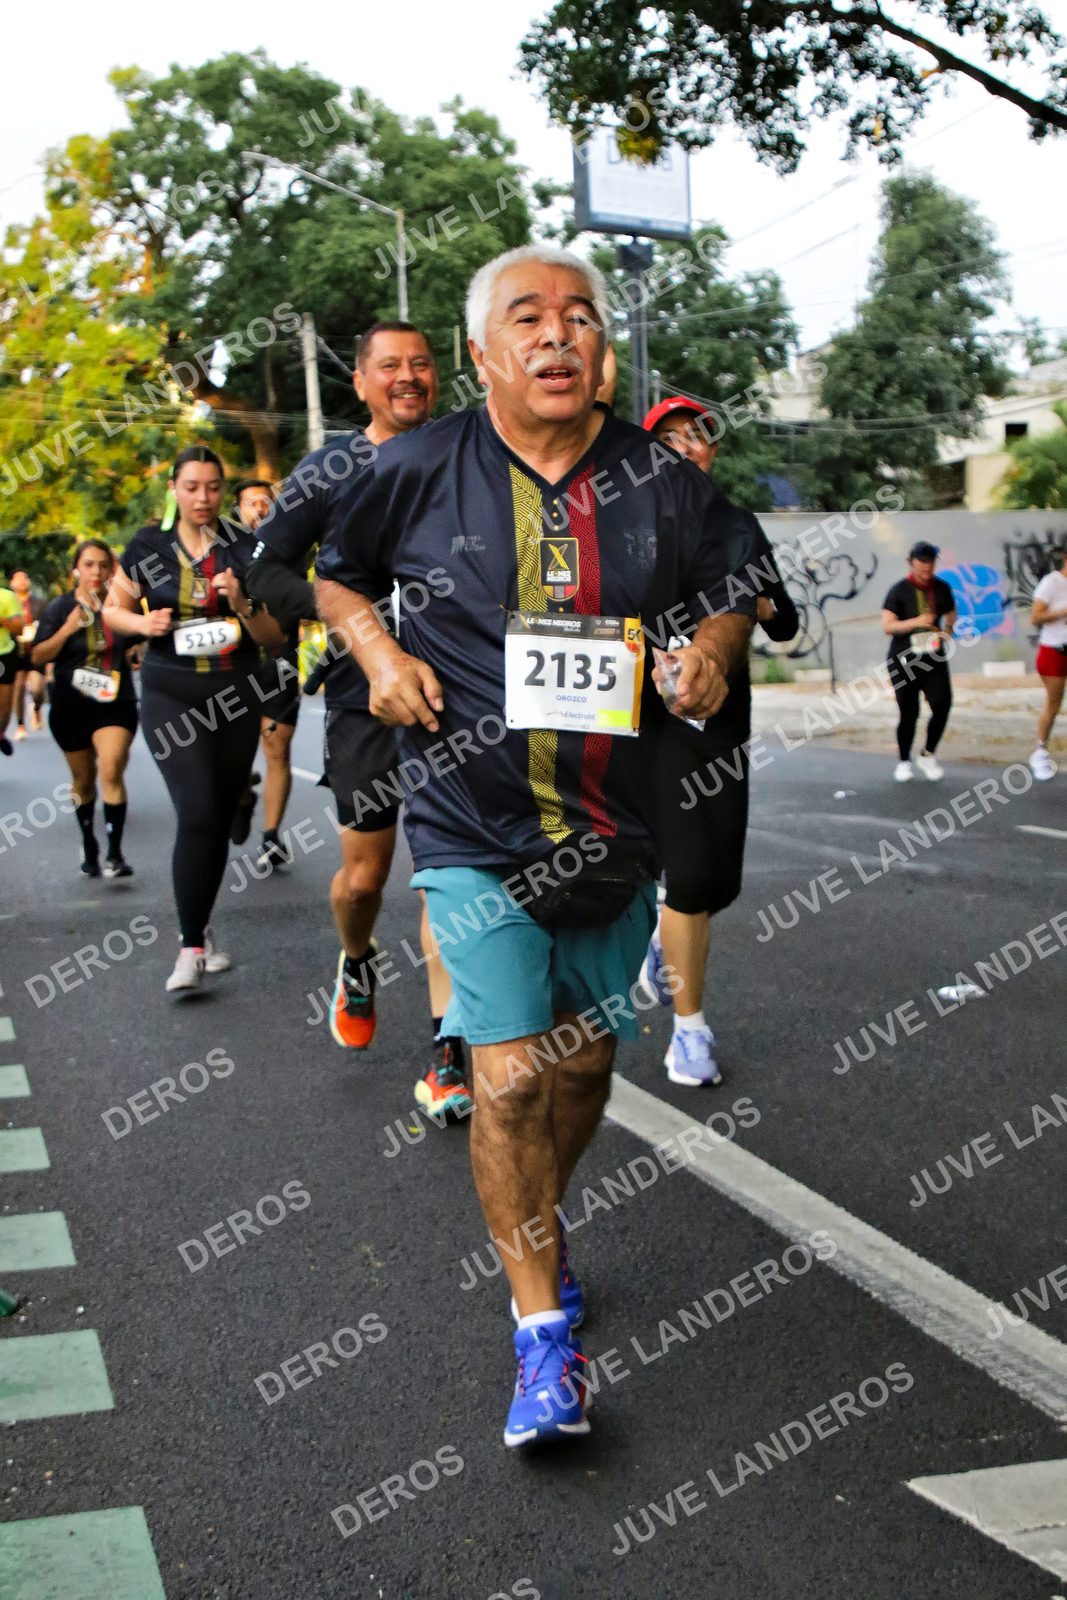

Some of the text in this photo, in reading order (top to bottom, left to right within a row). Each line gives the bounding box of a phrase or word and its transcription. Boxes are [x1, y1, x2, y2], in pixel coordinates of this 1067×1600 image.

[186, 628, 227, 648] 5215
[524, 650, 616, 691] 2135
[556, 695, 587, 703] OROZCO
